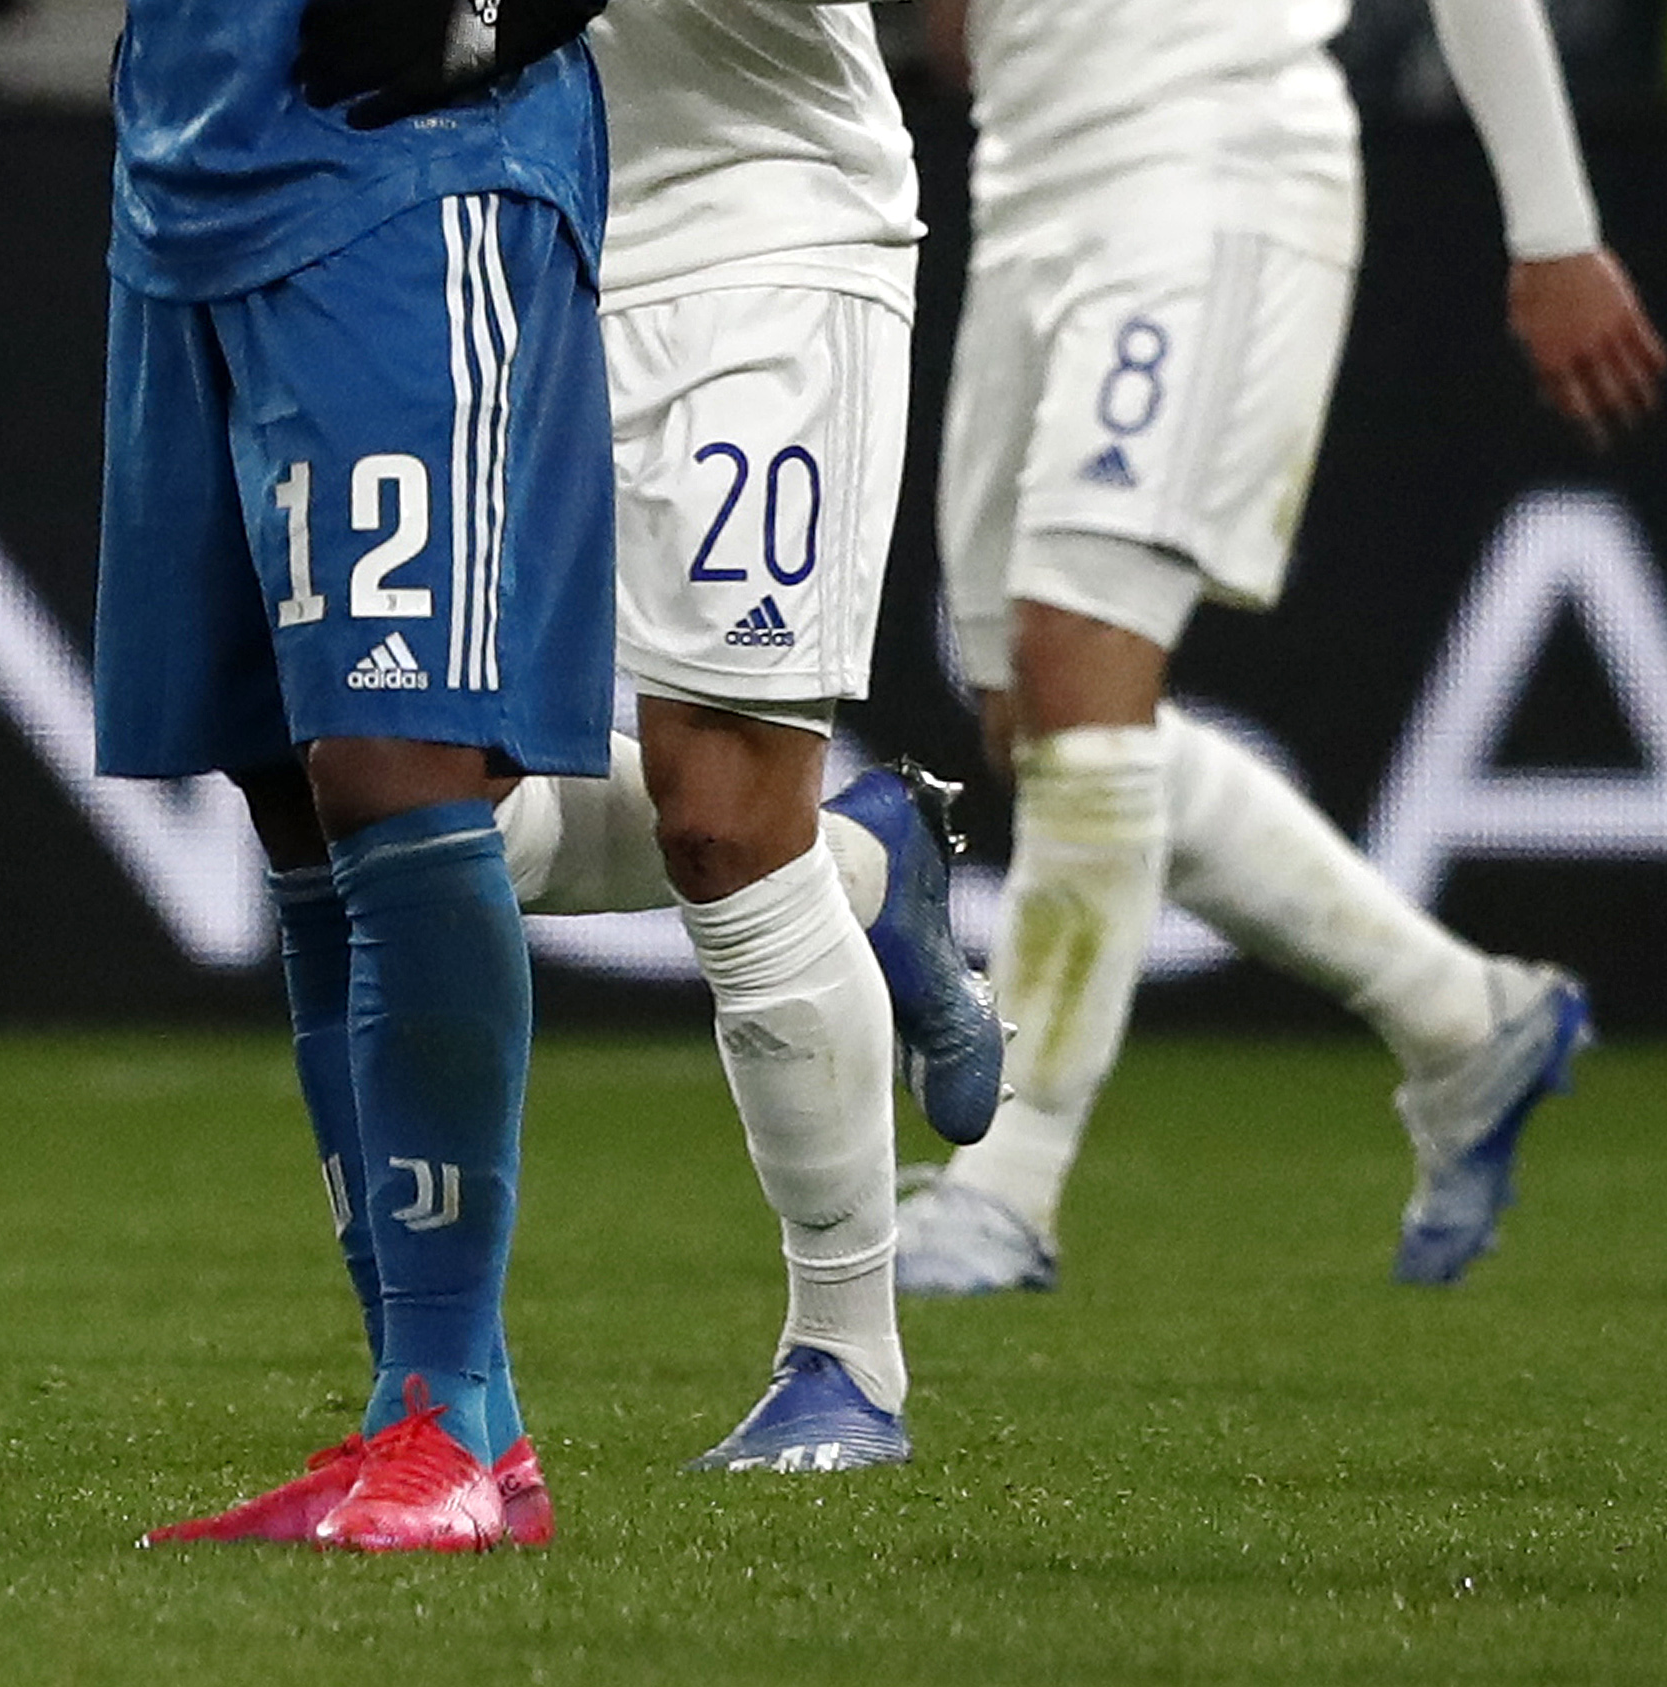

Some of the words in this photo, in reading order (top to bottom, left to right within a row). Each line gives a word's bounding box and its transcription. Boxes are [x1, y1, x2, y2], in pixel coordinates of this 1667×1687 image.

[1097, 317, 1168, 437] 8
[275, 453, 433, 629] 12
[689, 441, 821, 587] 20
[347, 668, 430, 690] adidas
[725, 627, 795, 648] adidas
